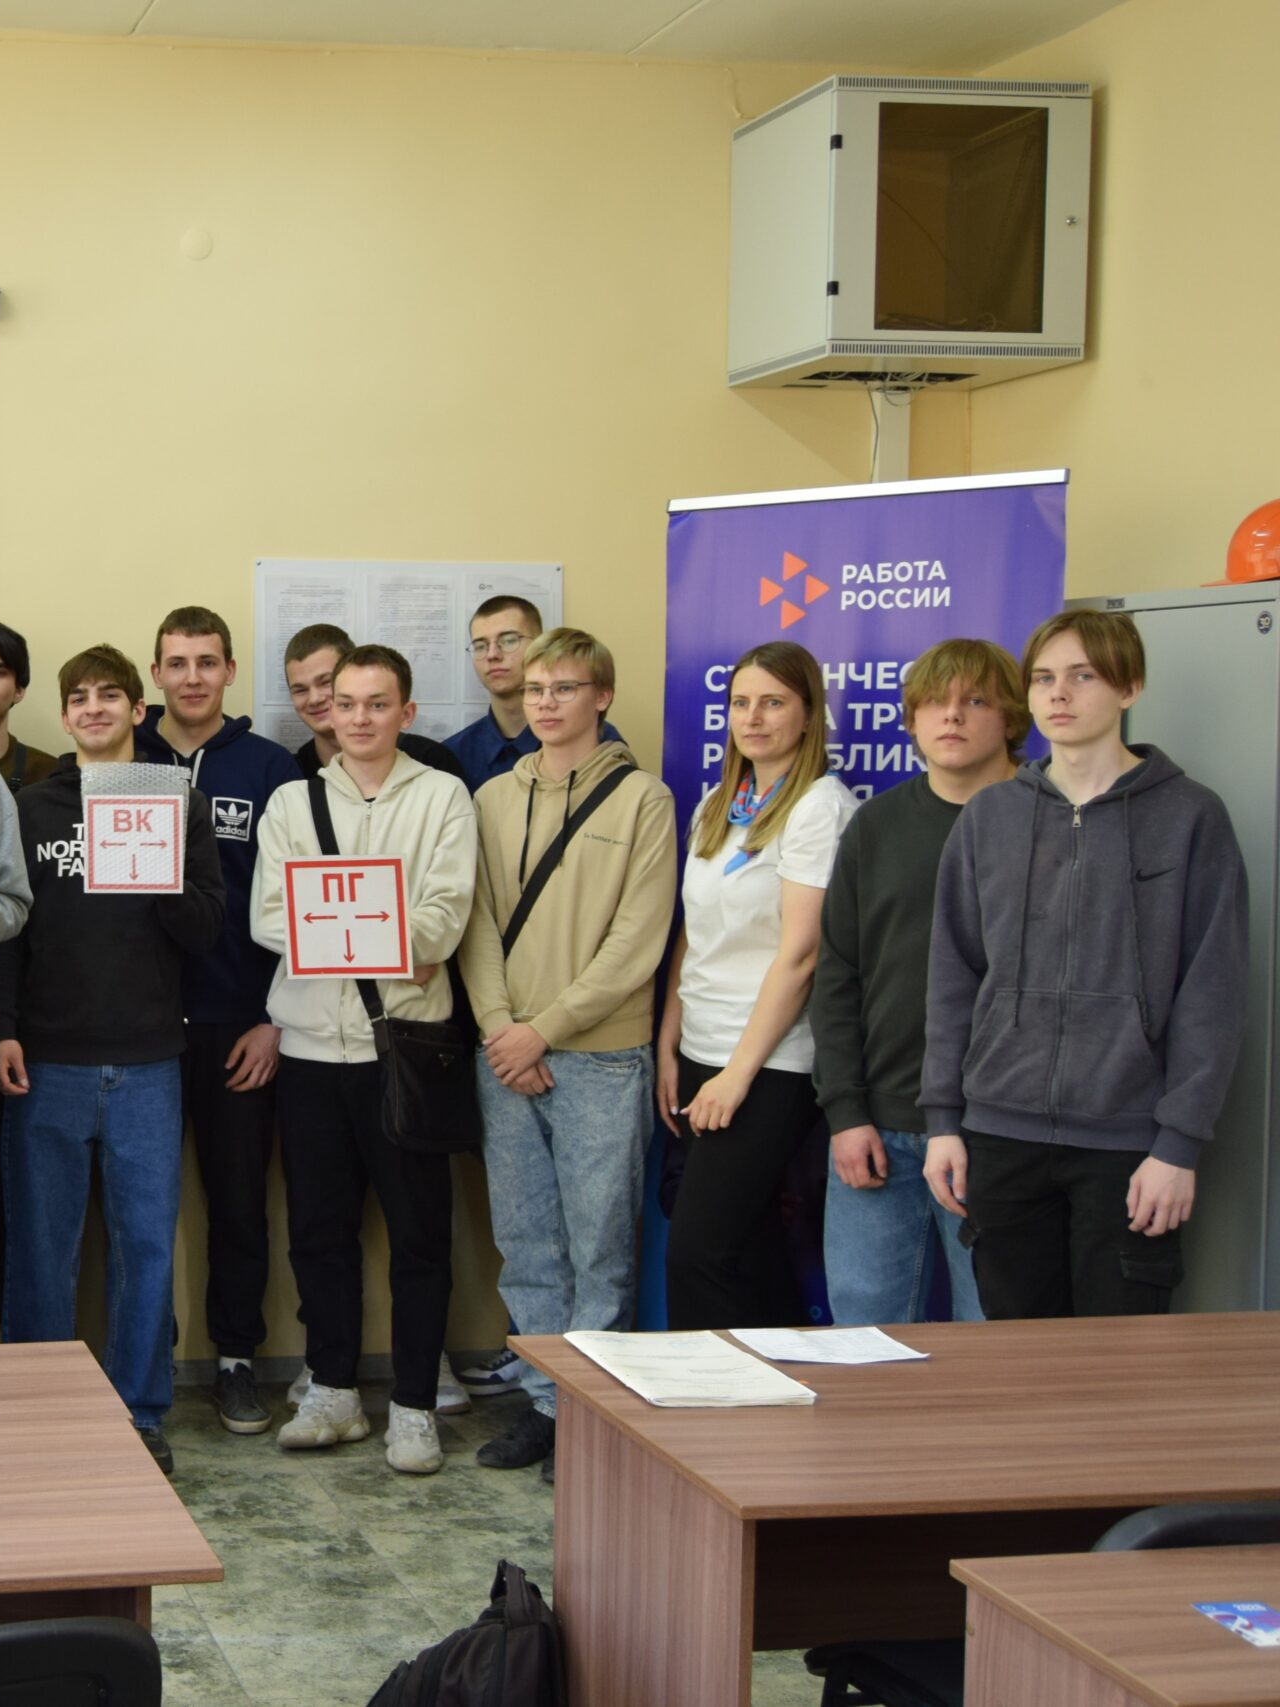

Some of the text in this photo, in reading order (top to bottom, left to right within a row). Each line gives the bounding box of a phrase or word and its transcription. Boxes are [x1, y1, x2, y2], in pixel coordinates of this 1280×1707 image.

[841, 560, 947, 585] РАБОТА
[840, 586, 952, 611] РОССИИ
[113, 808, 153, 833] ВК
[215, 825, 247, 838] adidas
[322, 872, 364, 903] ПГ
